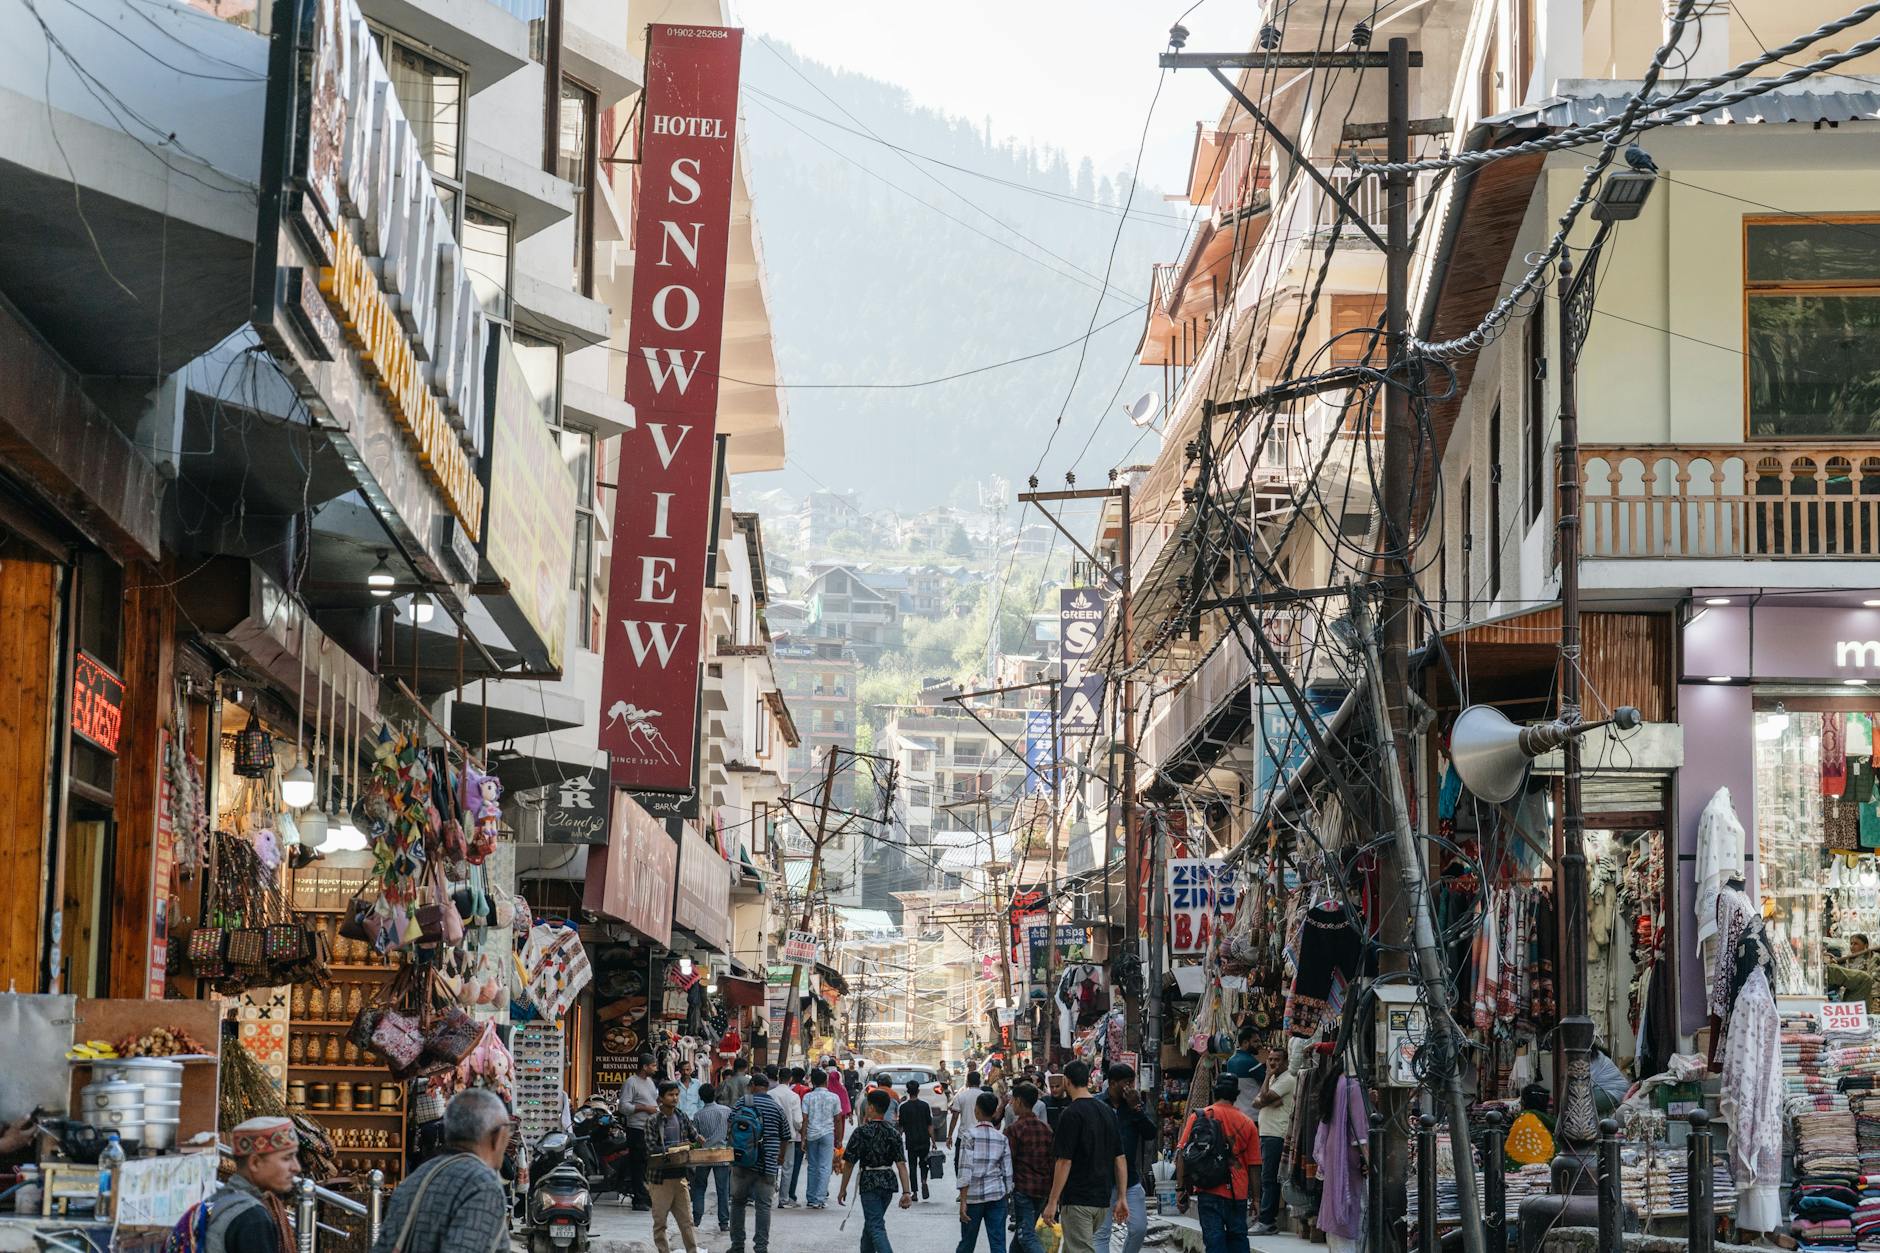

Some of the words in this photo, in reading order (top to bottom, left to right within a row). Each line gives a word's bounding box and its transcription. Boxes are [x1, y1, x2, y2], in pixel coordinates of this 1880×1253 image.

[666, 27, 728, 39] 01902-252684
[653, 114, 728, 138] HOTEL
[1061, 610, 1102, 620] GREEN
[1061, 620, 1101, 726] SPA
[611, 756, 637, 765] SINCE
[639, 757, 659, 766] 1937
[547, 811, 592, 828] Cloud
[1173, 864, 1235, 885] ZING
[1173, 887, 1236, 909] ZING
[789, 931, 817, 945] 24/7
[1065, 927, 1085, 938] spa
[789, 941, 816, 951] FOOD
[1823, 1003, 1864, 1016] SALE
[1829, 1017, 1860, 1029] 250
